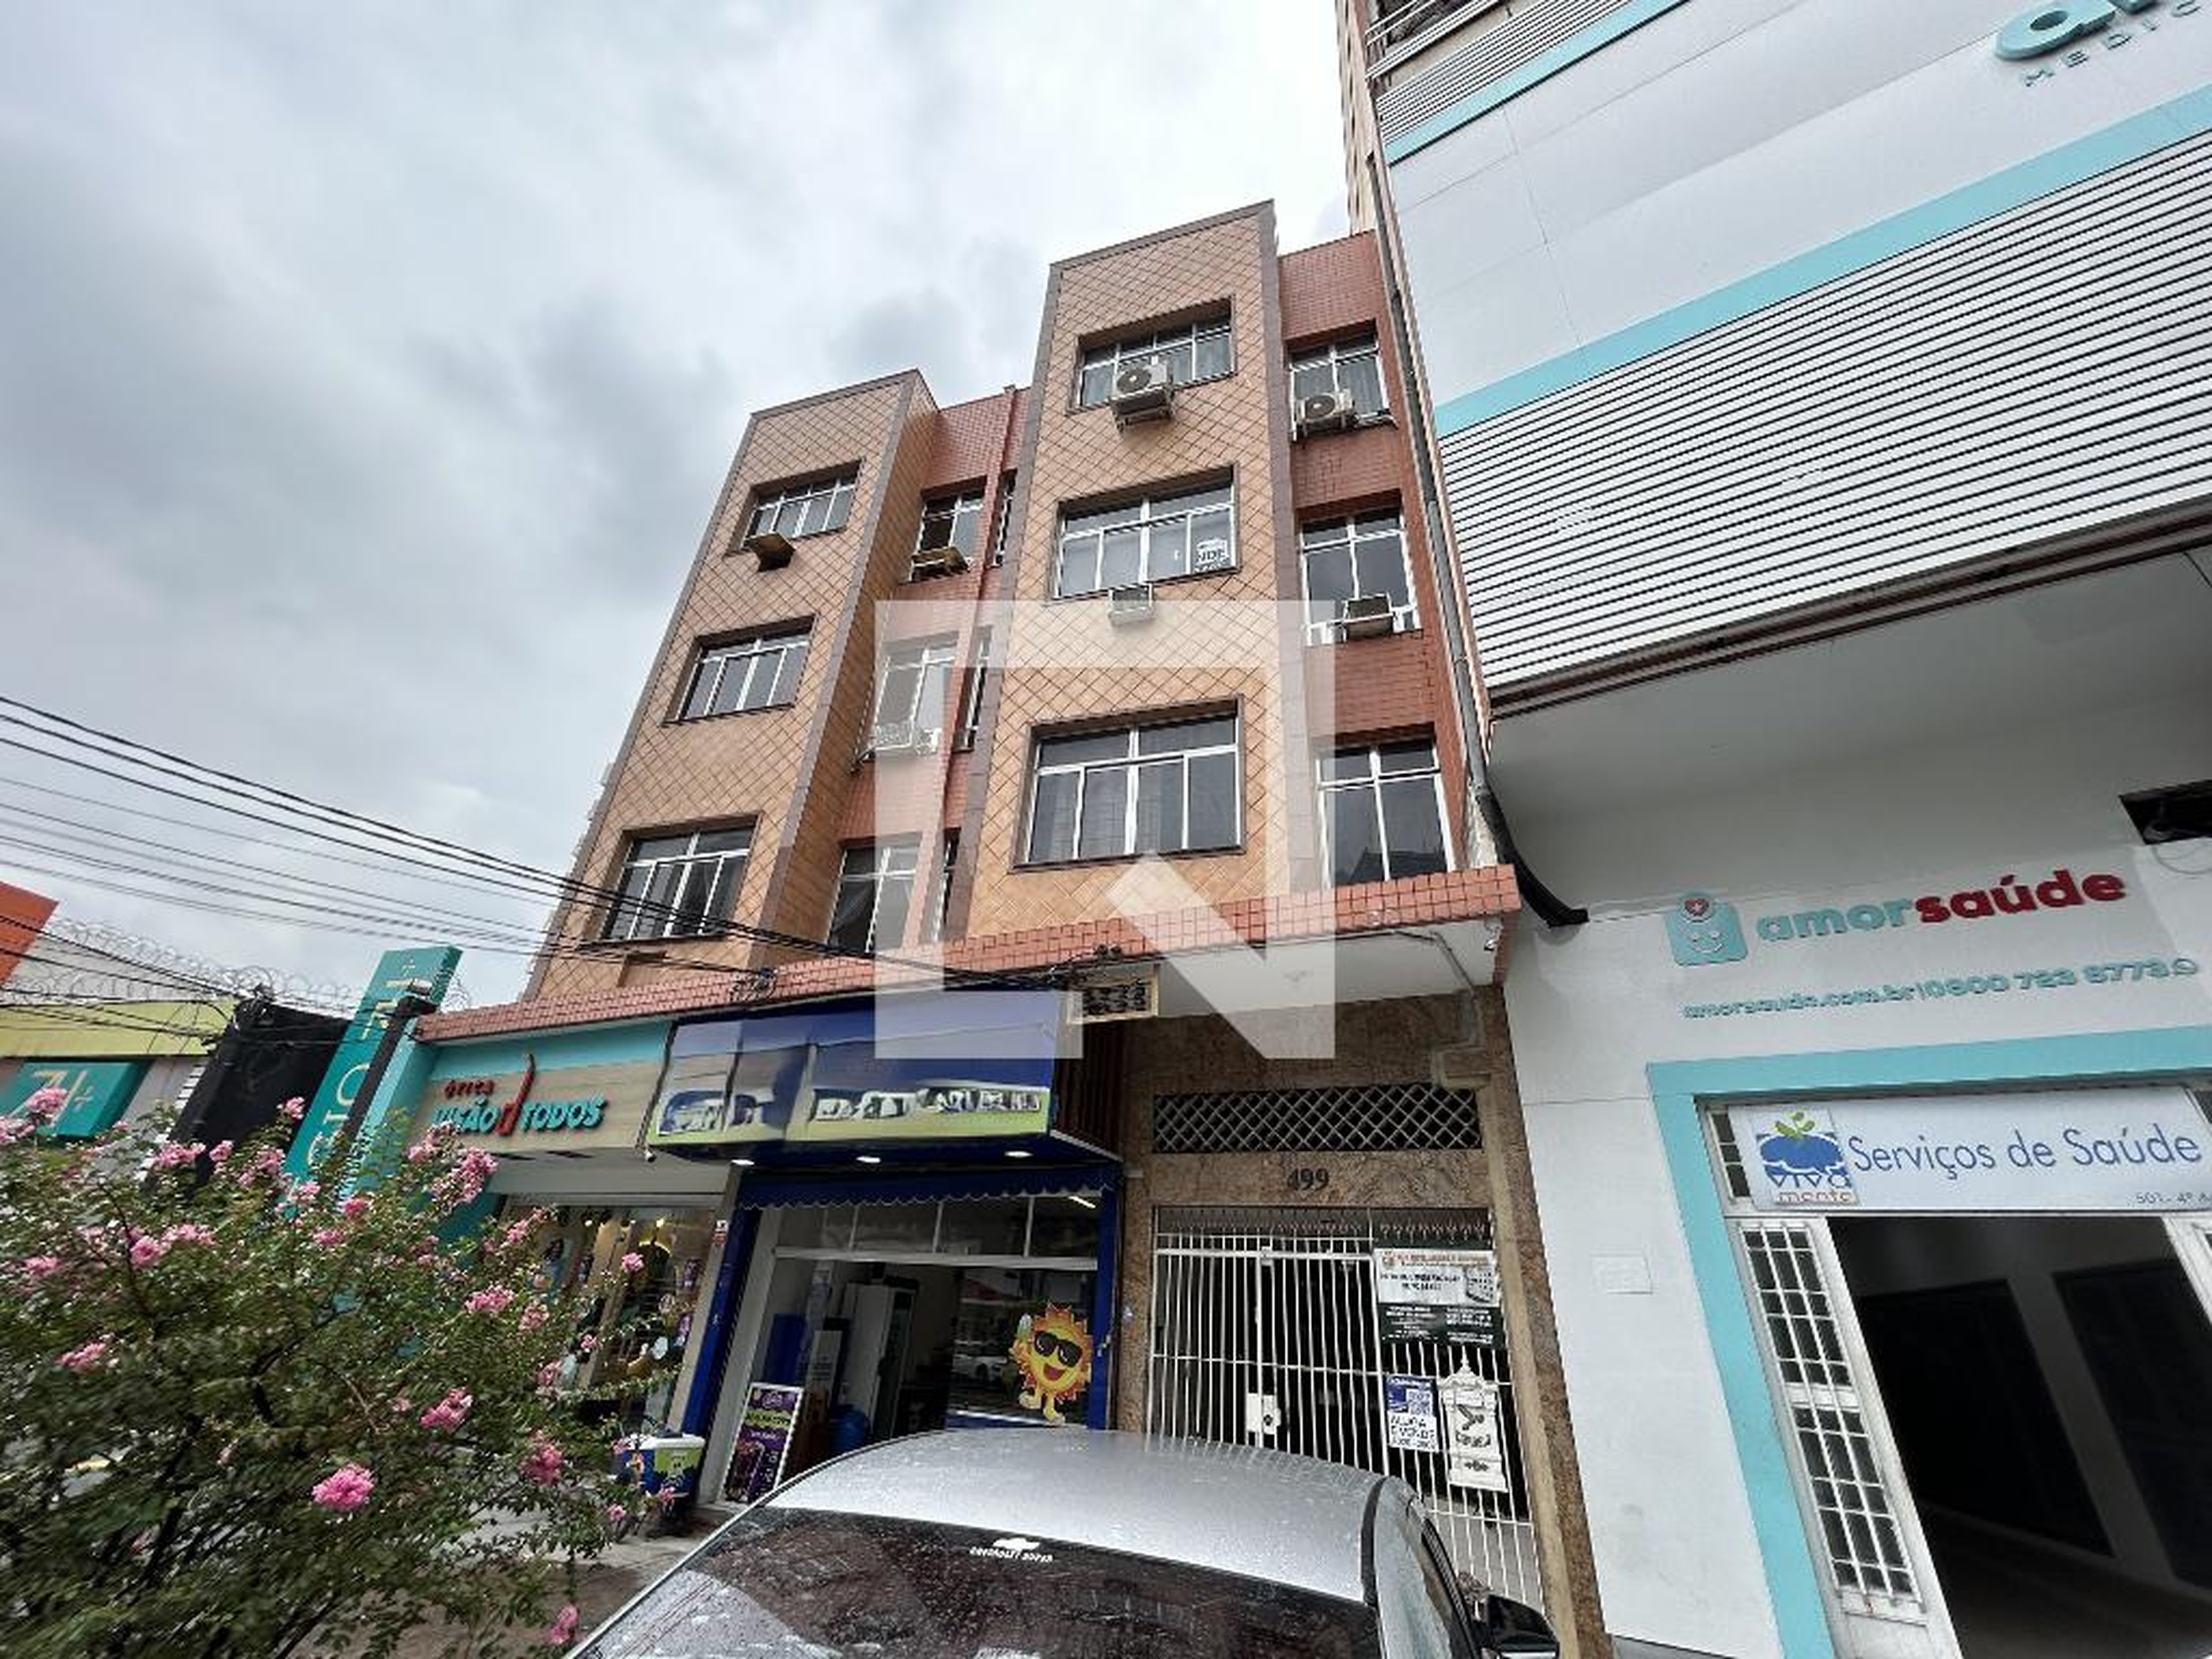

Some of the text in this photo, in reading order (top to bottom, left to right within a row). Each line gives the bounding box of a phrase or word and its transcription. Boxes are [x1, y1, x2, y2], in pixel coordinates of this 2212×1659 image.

[1758, 869, 2126, 941] amorsaúde
[522, 1093, 608, 1132] TODOS
[1848, 1123, 2202, 1180] Serviços de Saúde
